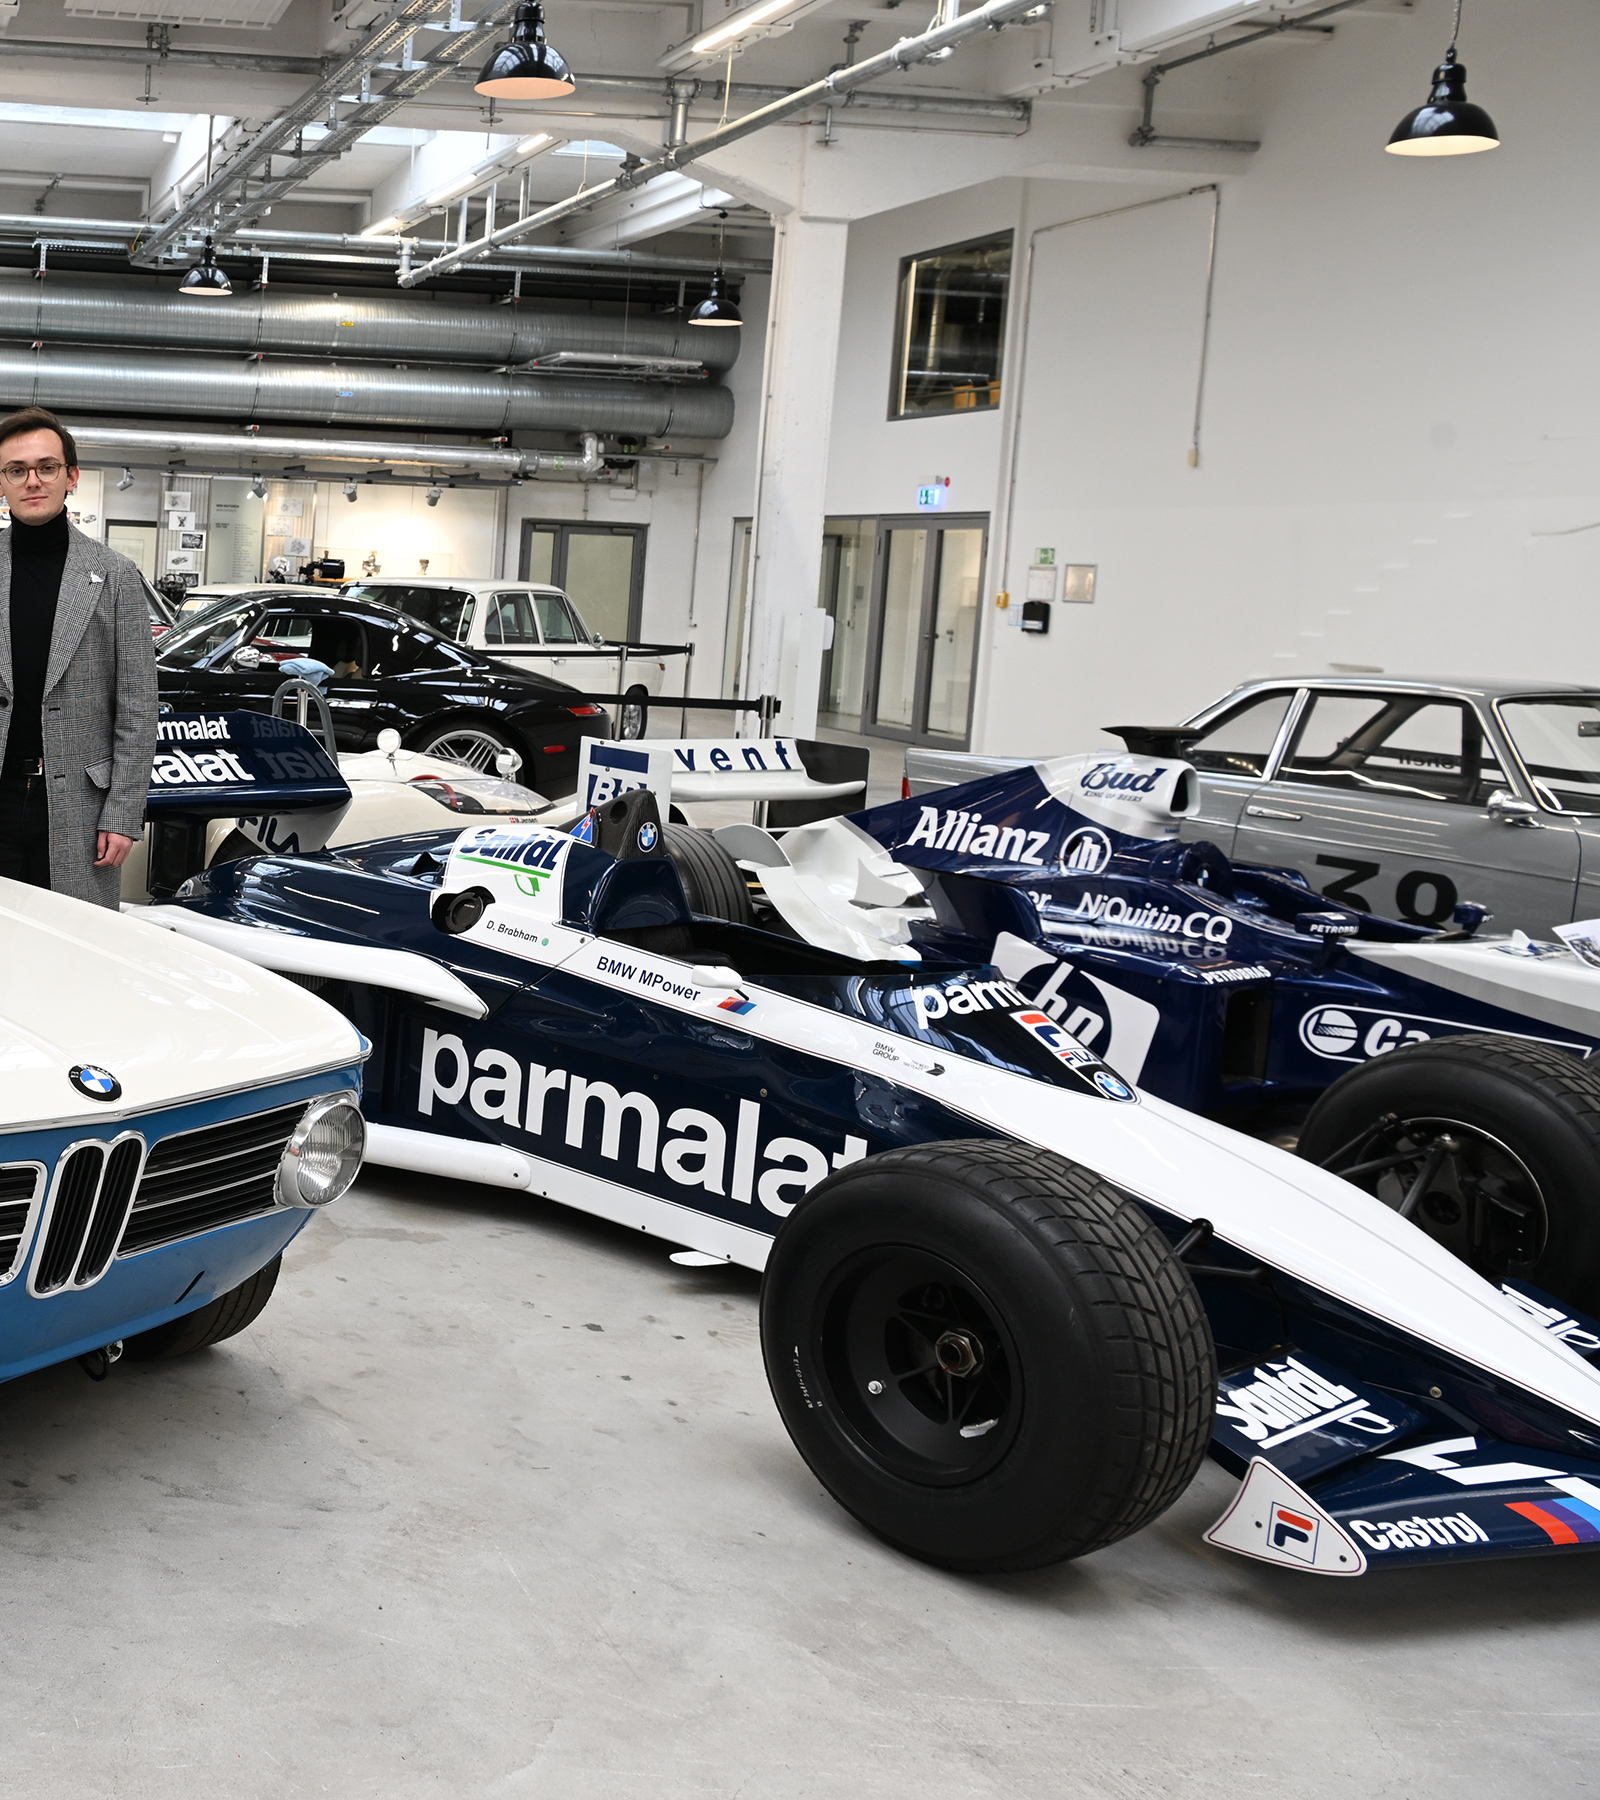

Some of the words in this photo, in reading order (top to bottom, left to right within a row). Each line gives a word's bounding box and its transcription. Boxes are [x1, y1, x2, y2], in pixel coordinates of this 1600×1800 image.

[156, 715, 231, 740] rmalat
[1080, 763, 1168, 793] Bud
[1083, 790, 1103, 798] KING
[1117, 794, 1144, 802] BEERS
[906, 805, 1051, 866] Allianz
[486, 920, 495, 931] D.
[497, 924, 538, 943] Brabham
[596, 956, 638, 980] BMW
[638, 969, 701, 1001] MPower
[1201, 965, 1272, 985] PETROBRAS
[872, 1048, 900, 1062] GROUP
[874, 1041, 896, 1054] BMW
[1348, 1512, 1491, 1552] Castrol
